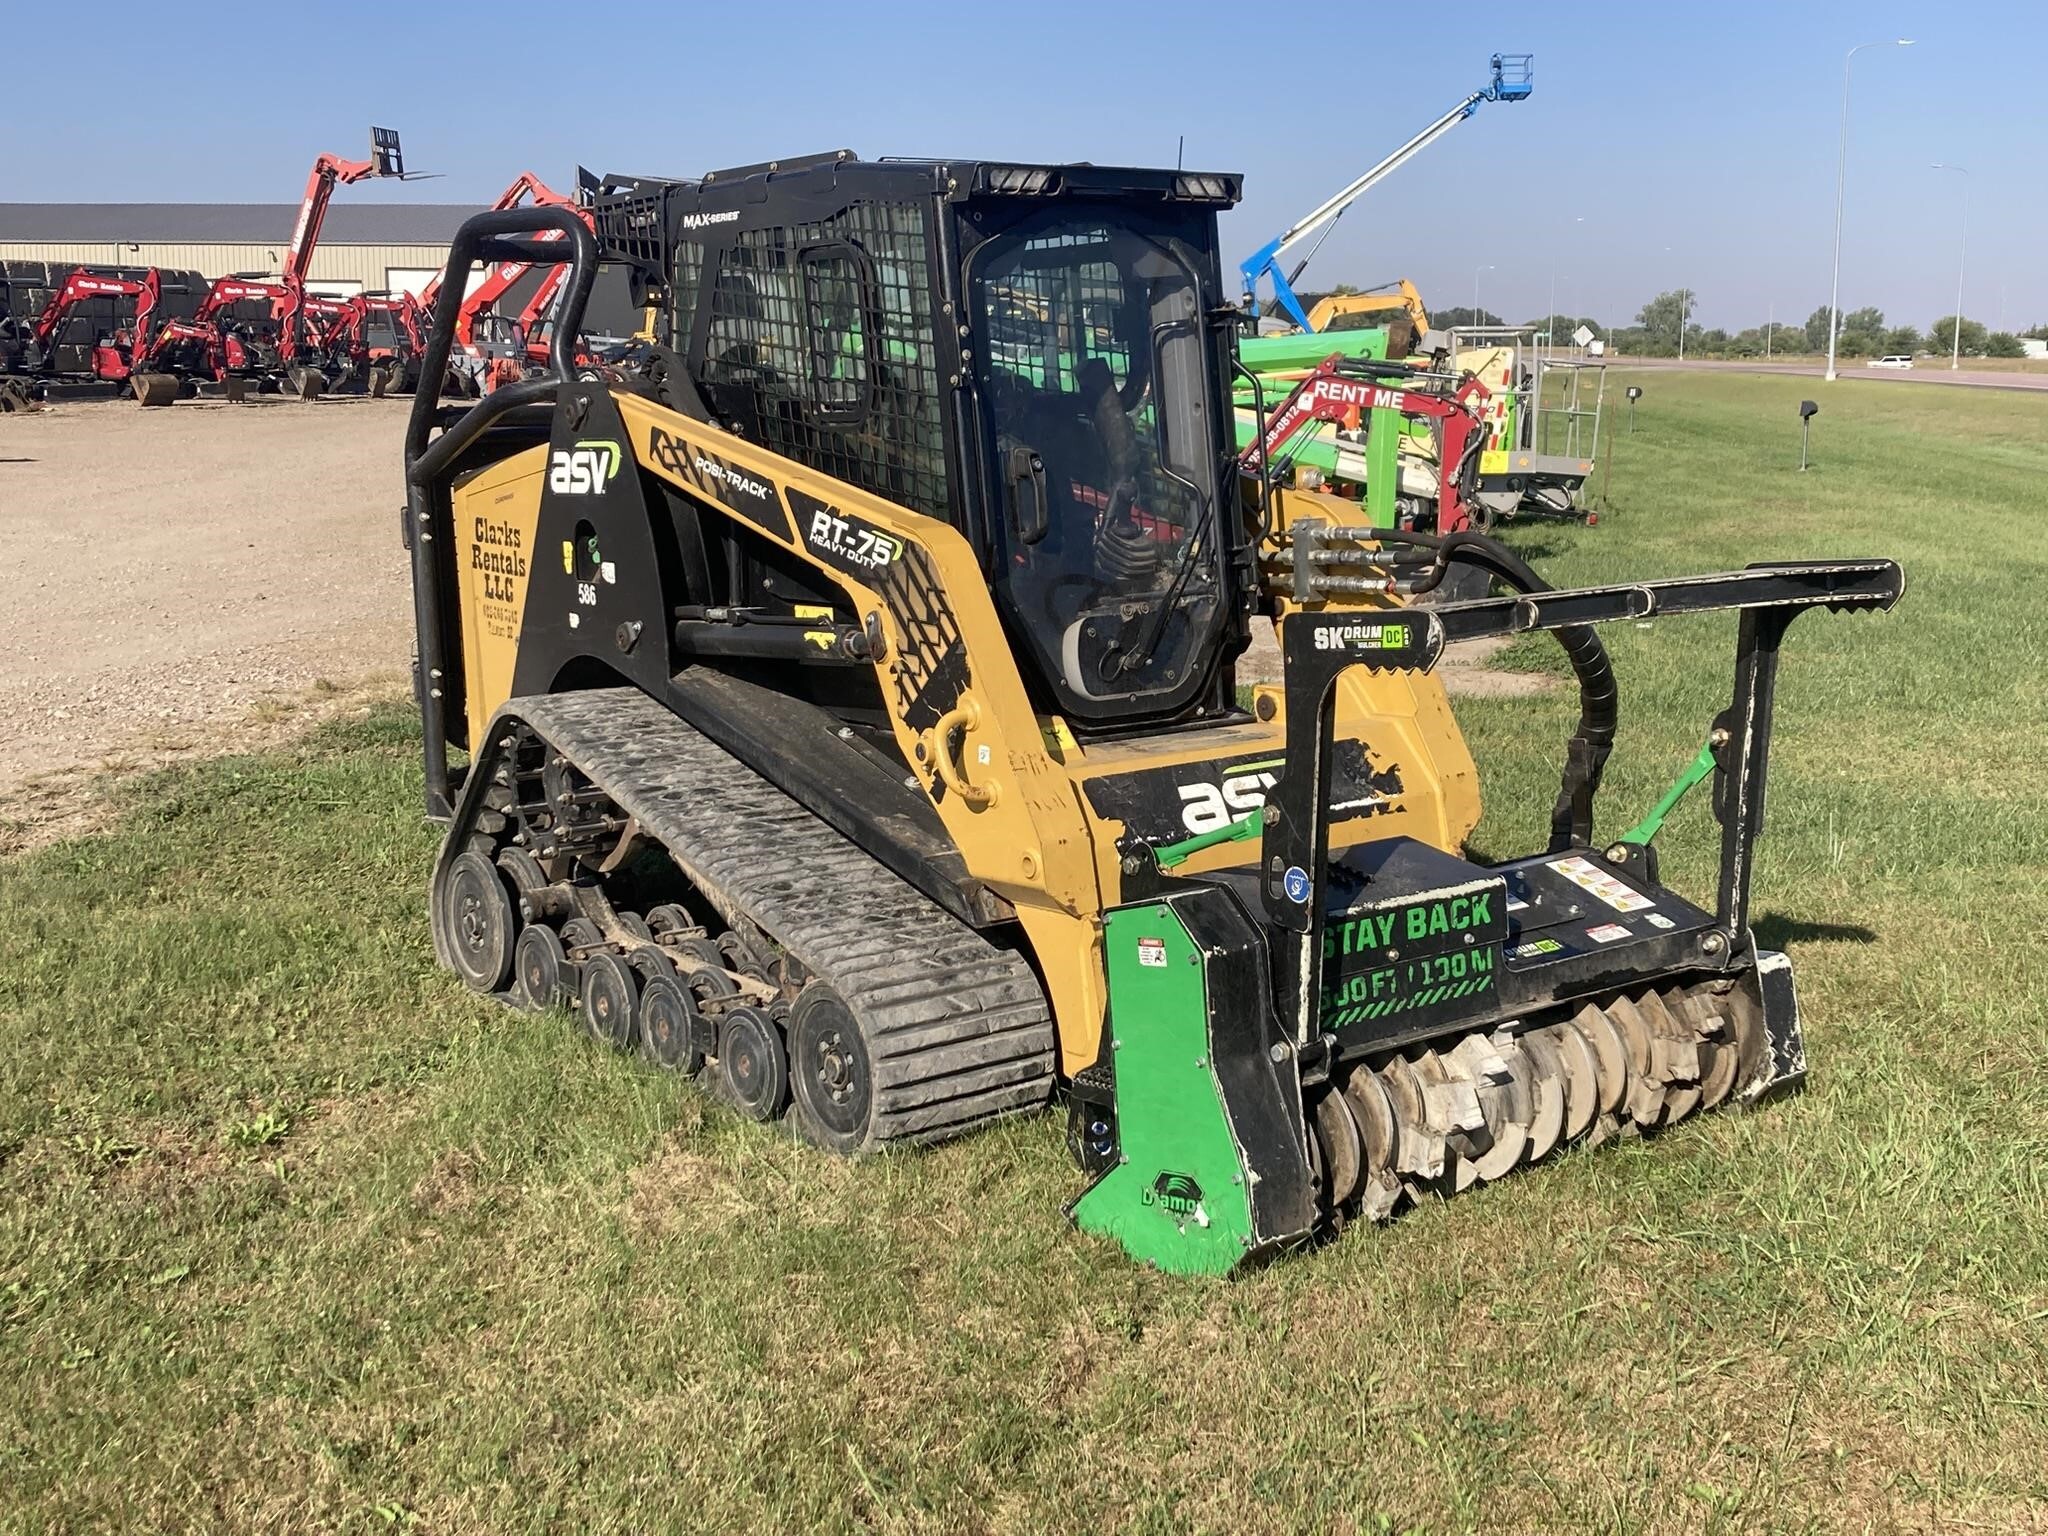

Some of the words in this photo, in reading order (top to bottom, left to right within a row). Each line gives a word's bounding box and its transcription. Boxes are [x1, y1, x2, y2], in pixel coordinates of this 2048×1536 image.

[683, 211, 739, 230] MAX-SERIES
[1314, 381, 1370, 404] RENT
[1373, 389, 1405, 409] ME
[694, 456, 767, 500] POSI-TRACK
[475, 516, 521, 549] Clarks
[810, 510, 893, 566] RT-75
[472, 543, 526, 578] Rentals
[809, 533, 848, 557] HEAVY
[846, 547, 877, 571] DUTY
[484, 573, 514, 603] LLC
[578, 583, 597, 606] 586
[1323, 912, 1396, 959] STAY
[1406, 892, 1492, 940] BACK
[1471, 946, 1494, 974] M
